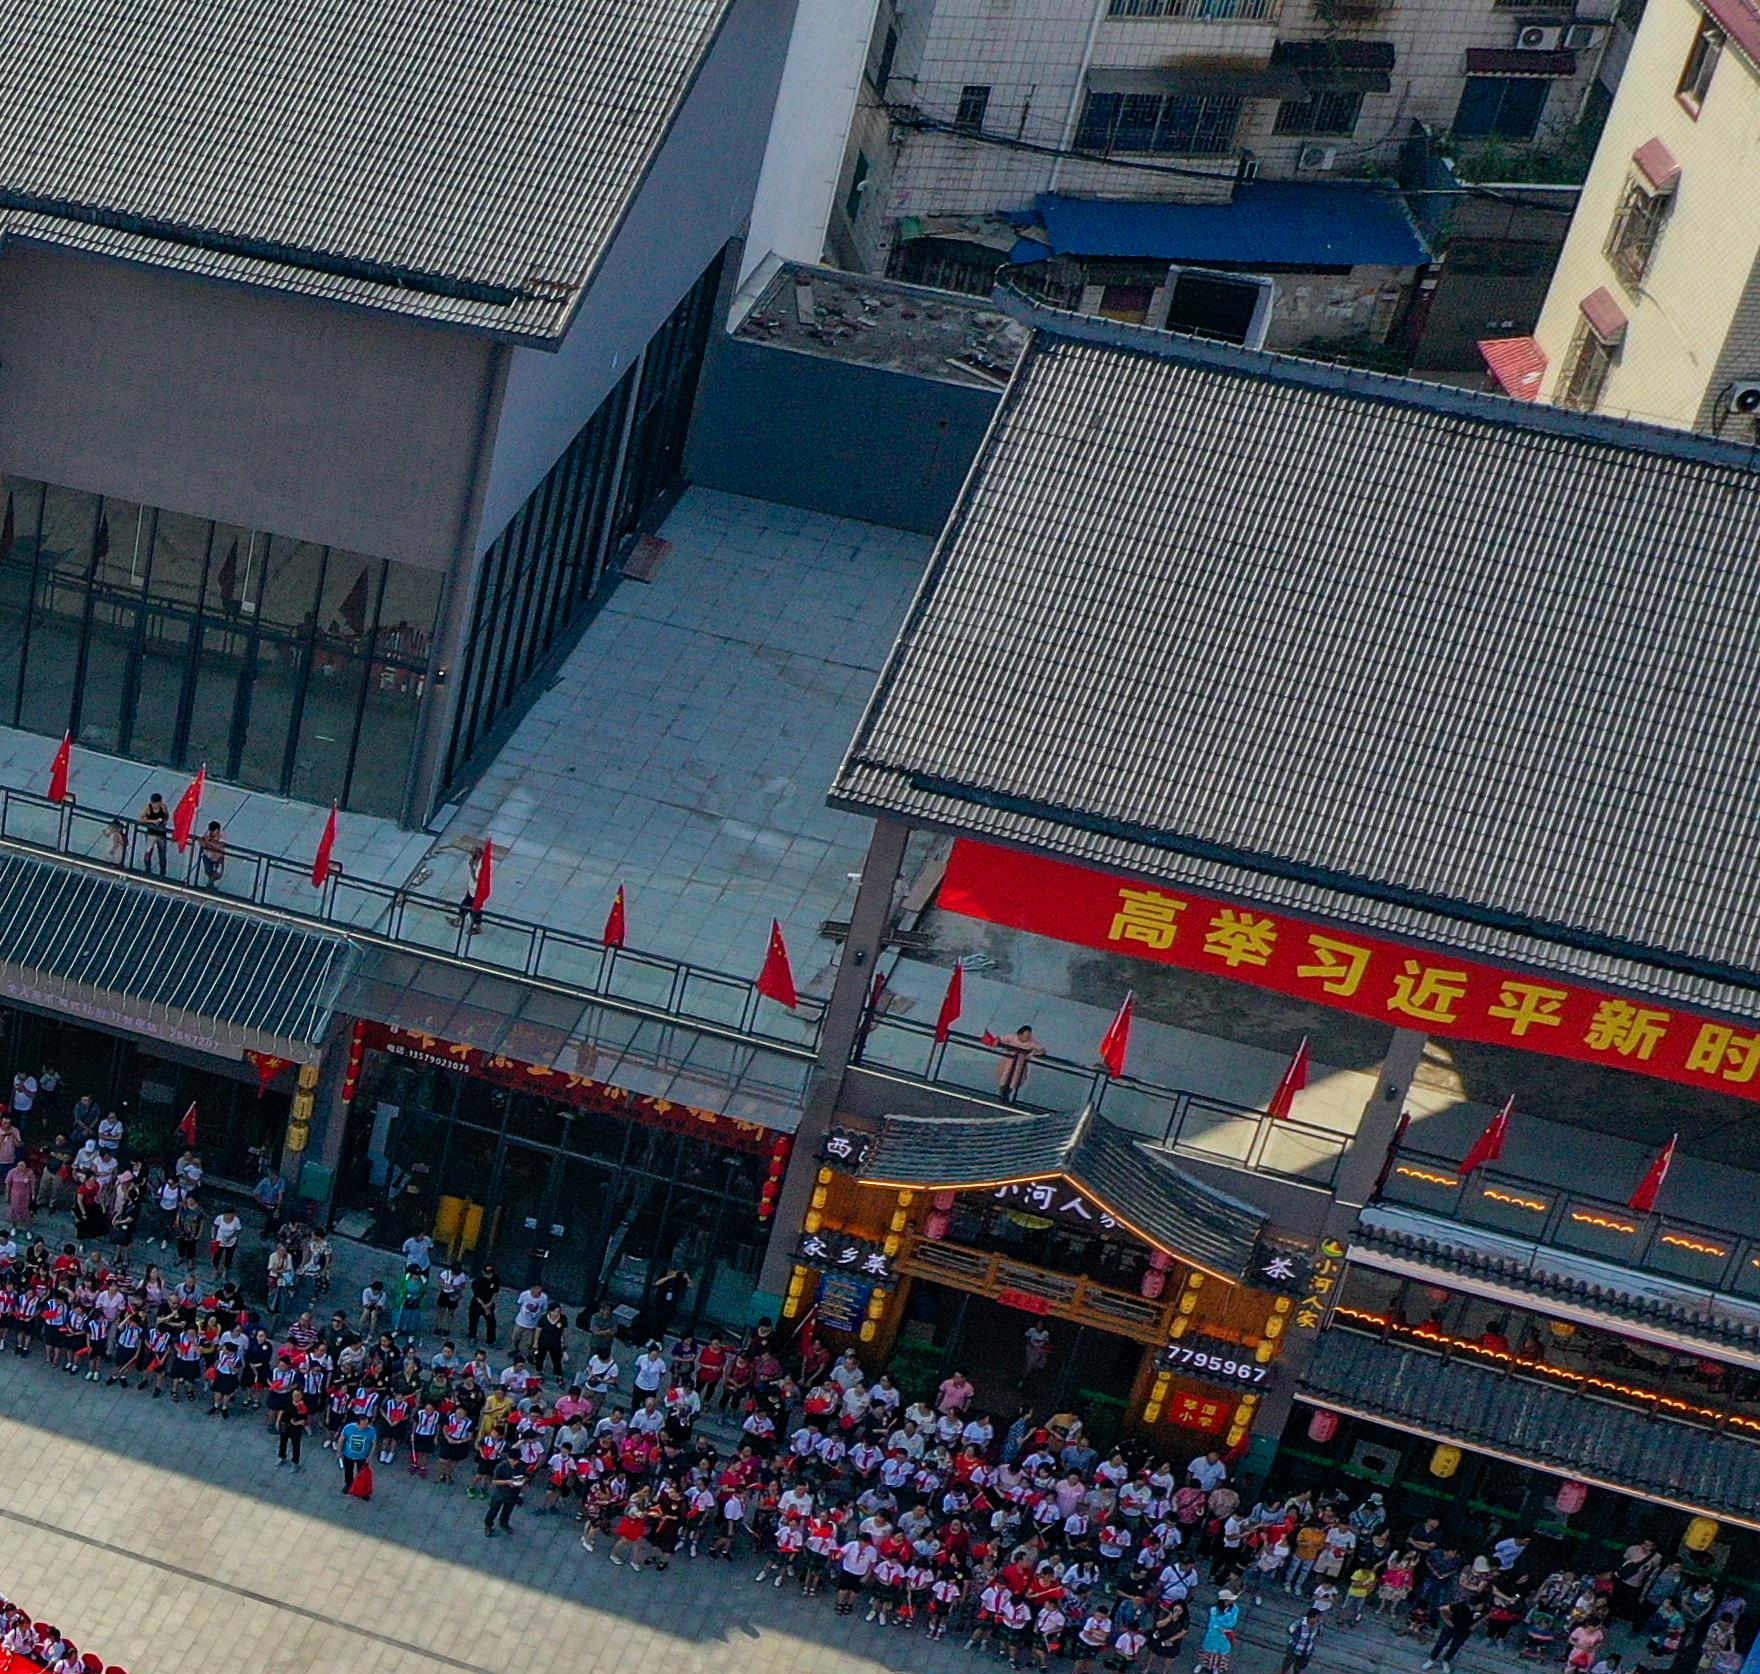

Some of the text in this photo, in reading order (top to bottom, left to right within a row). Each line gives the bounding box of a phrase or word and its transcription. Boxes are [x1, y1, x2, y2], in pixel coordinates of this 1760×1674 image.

[1107, 887, 1760, 1083] 高举习近平新时
[1295, 1259, 1339, 1329] 小河人家
[1167, 1345, 1267, 1382] 7795967
